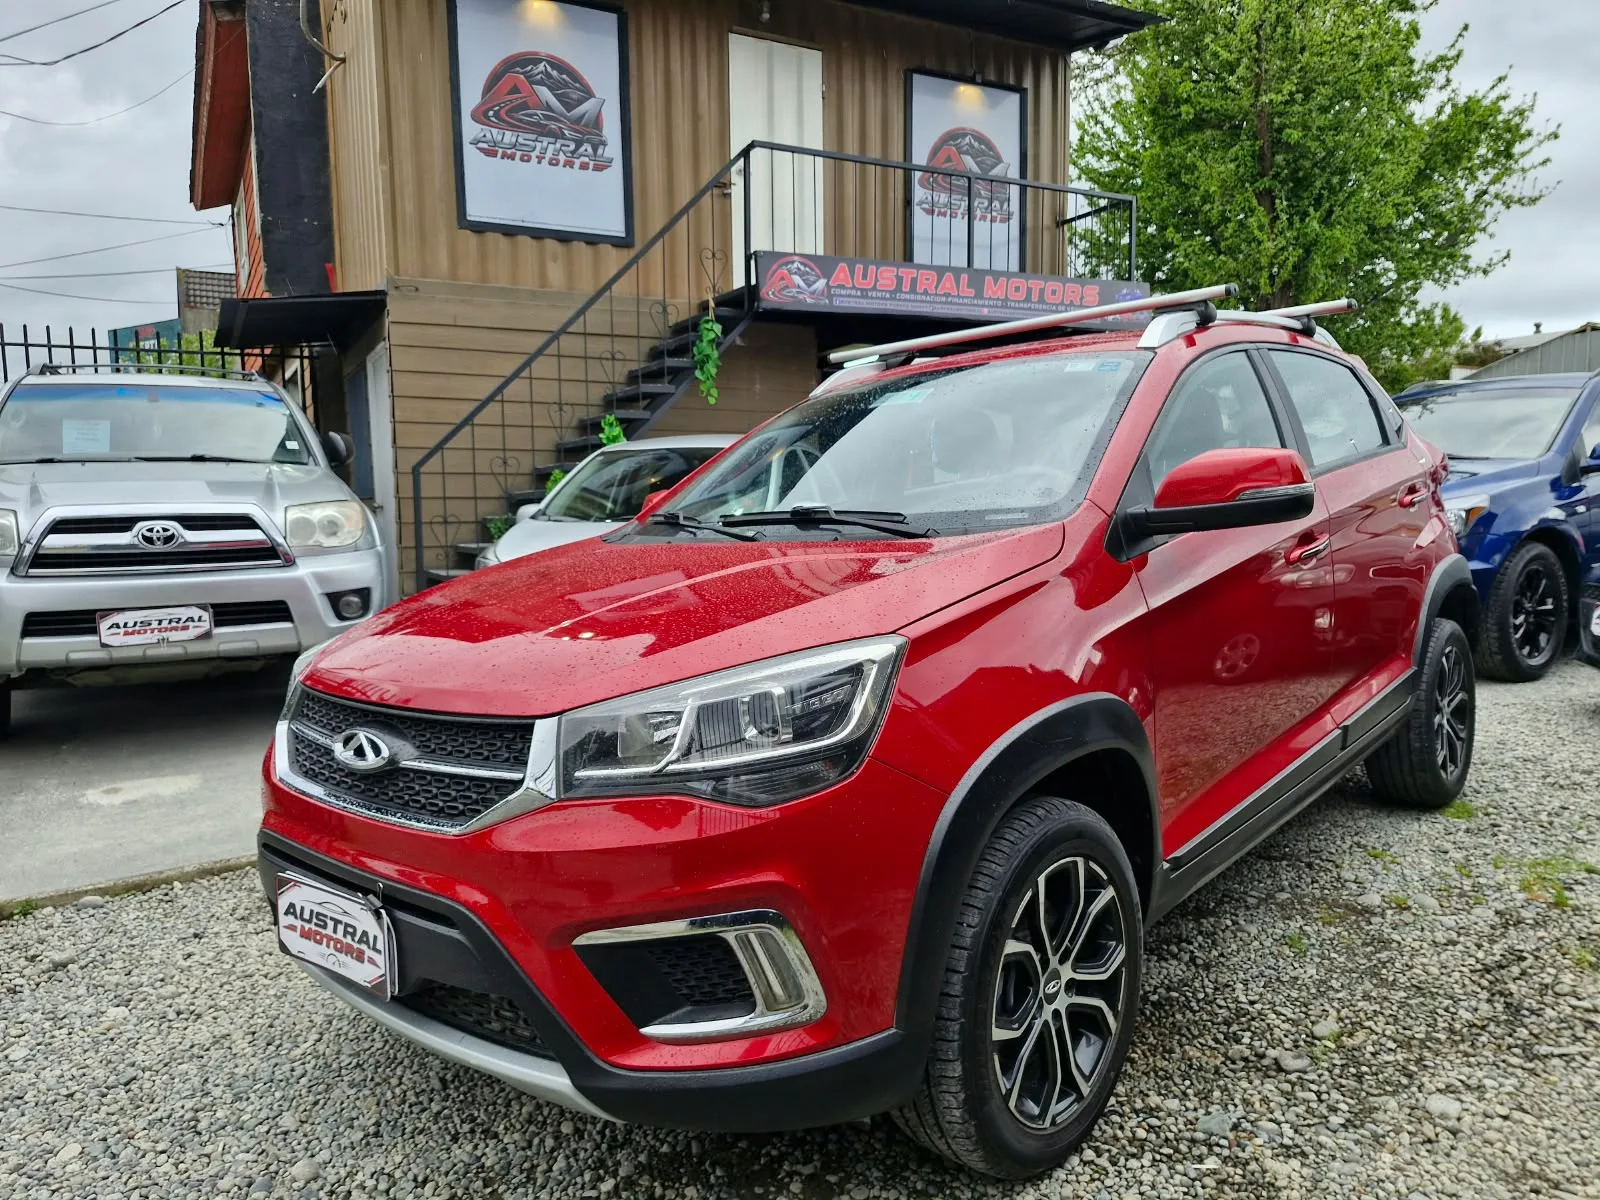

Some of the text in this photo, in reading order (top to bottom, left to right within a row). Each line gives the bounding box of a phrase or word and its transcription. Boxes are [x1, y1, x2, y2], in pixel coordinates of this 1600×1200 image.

[469, 128, 614, 163] AUSTRAL
[500, 150, 591, 171] MOTORS
[829, 262, 1100, 306] AUSTRAL MOTORS
[831, 288, 861, 297] COMPRA
[867, 291, 890, 299] VENTA
[1007, 301, 1057, 311] TRANSFERENCIA
[106, 615, 207, 631] AUSTRAL
[122, 625, 190, 637] MOTORS
[283, 901, 382, 955] AUSTRAL
[299, 924, 366, 964] MOTORS
